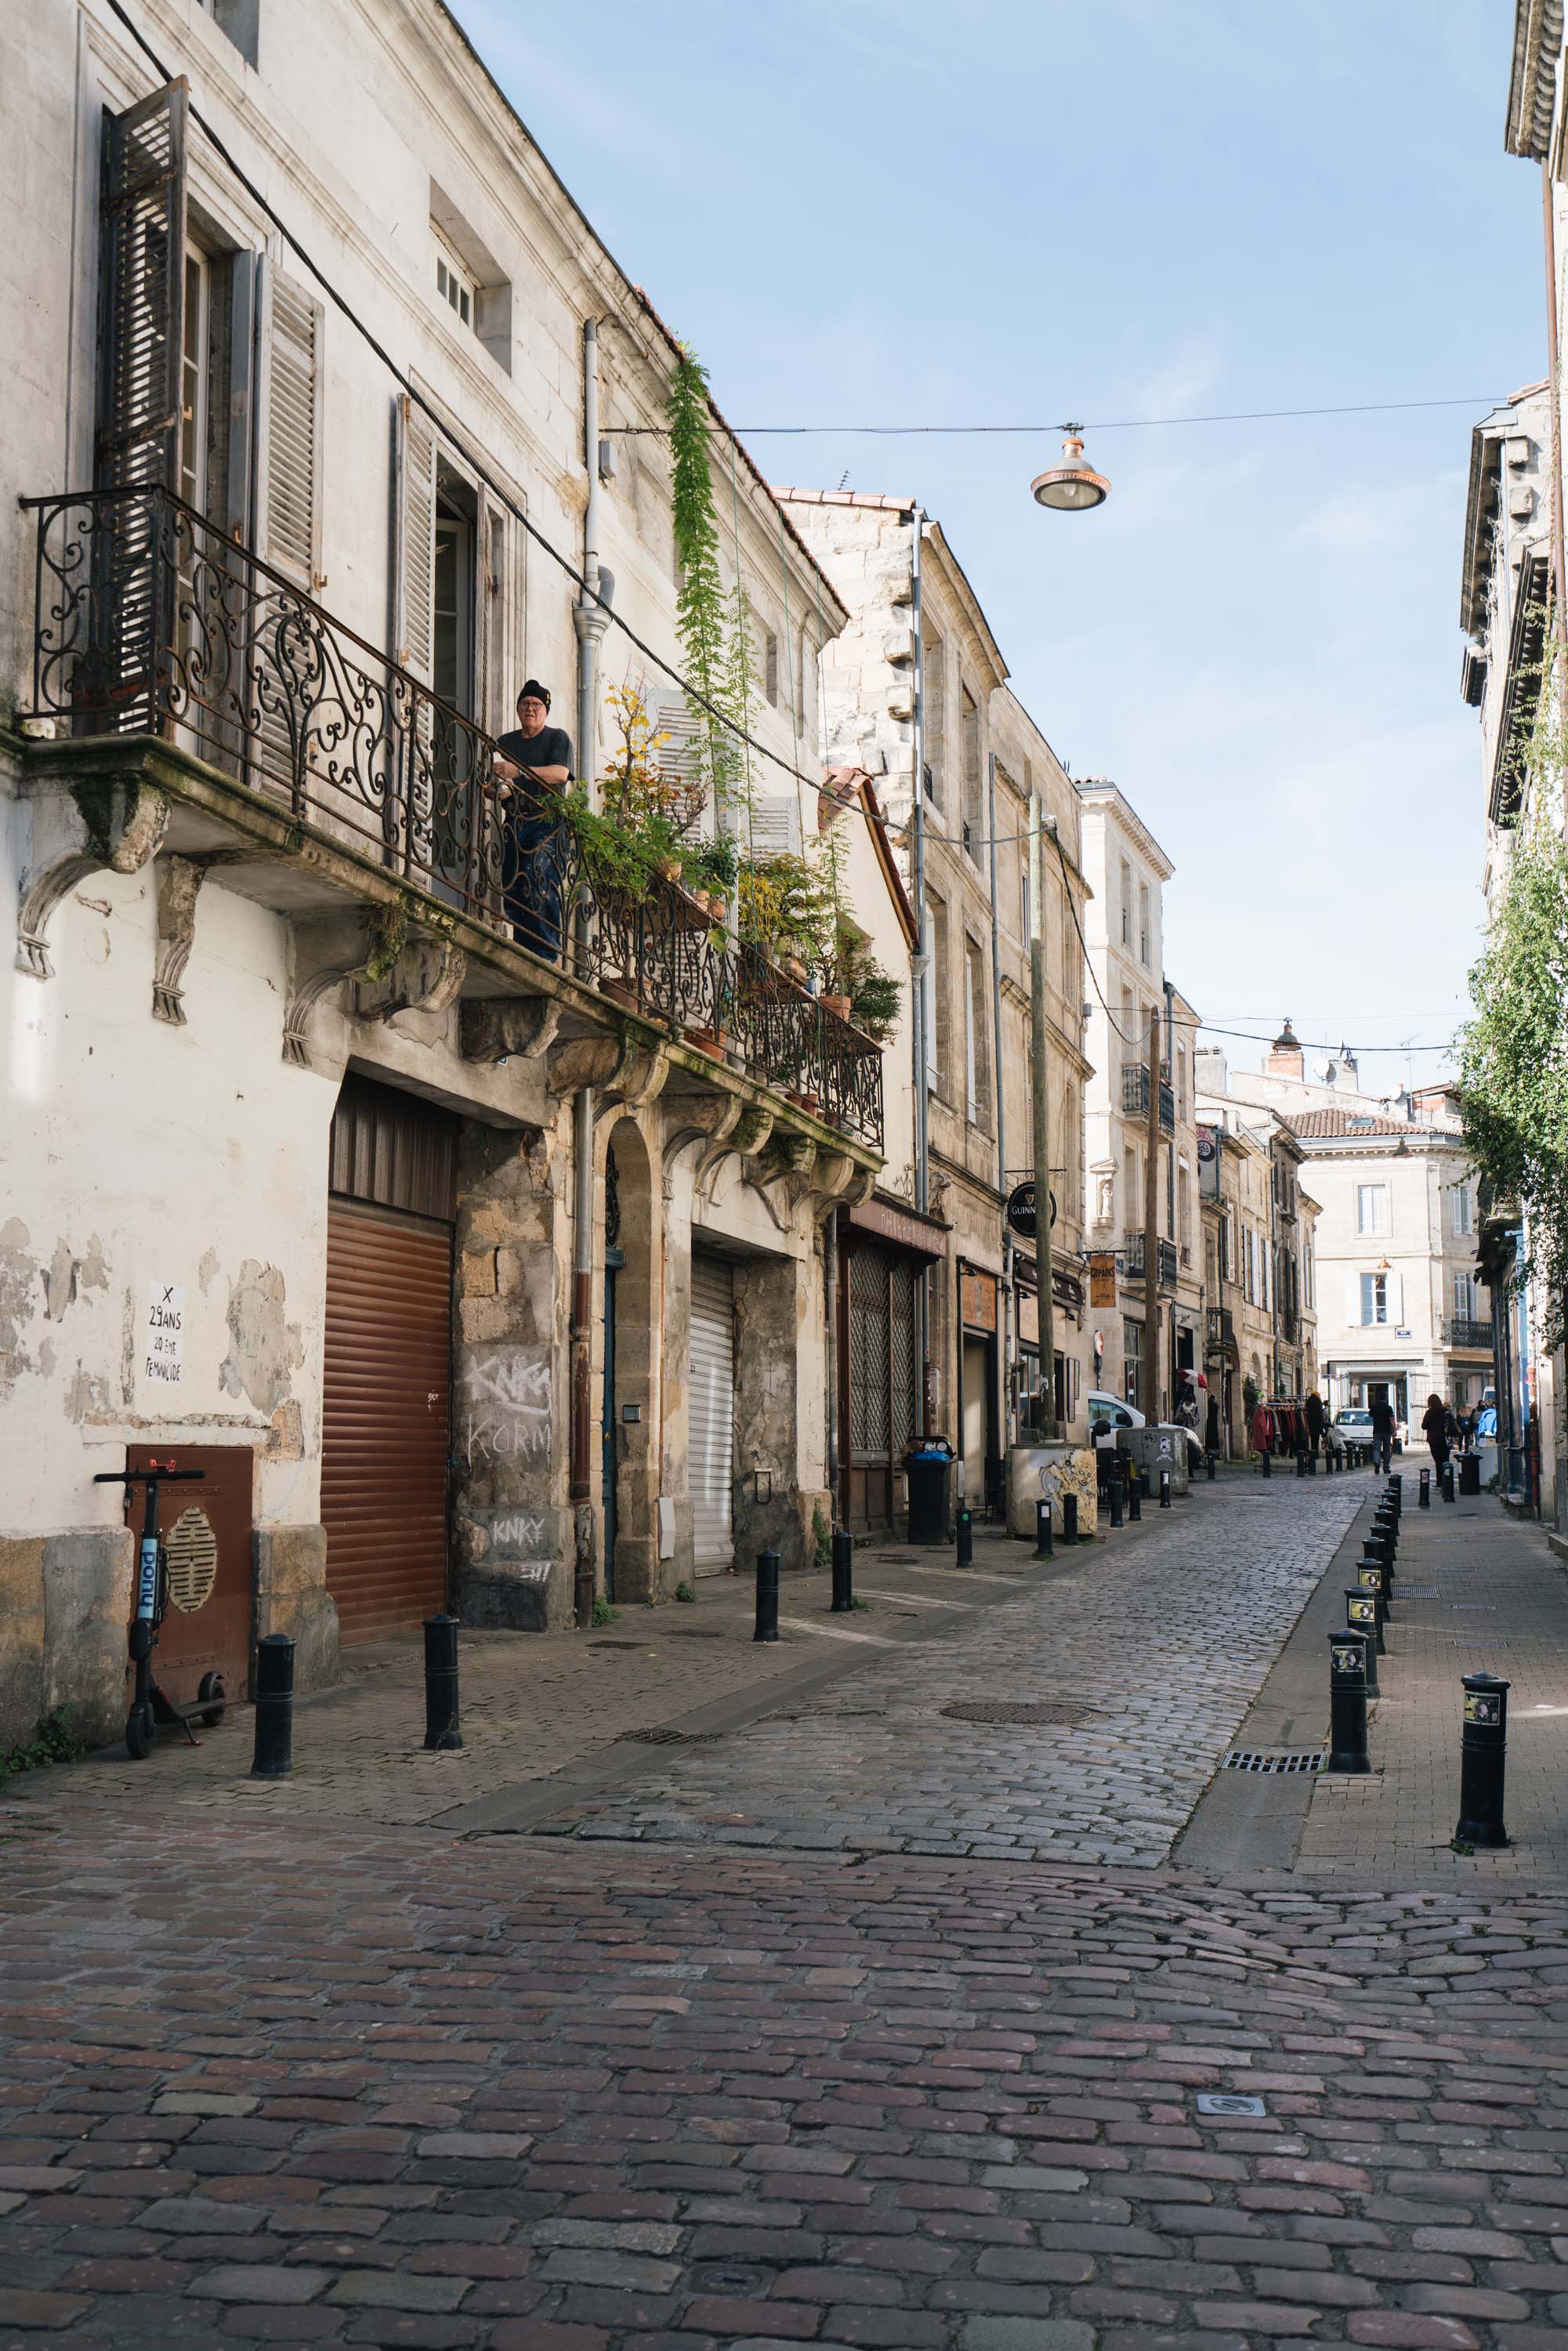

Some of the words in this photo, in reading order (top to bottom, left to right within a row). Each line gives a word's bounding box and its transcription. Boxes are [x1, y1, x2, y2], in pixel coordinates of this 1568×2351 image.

[1012, 1205, 1036, 1215] GUINN
[162, 1286, 173, 1303] X
[140, 1551, 156, 1607] pony
